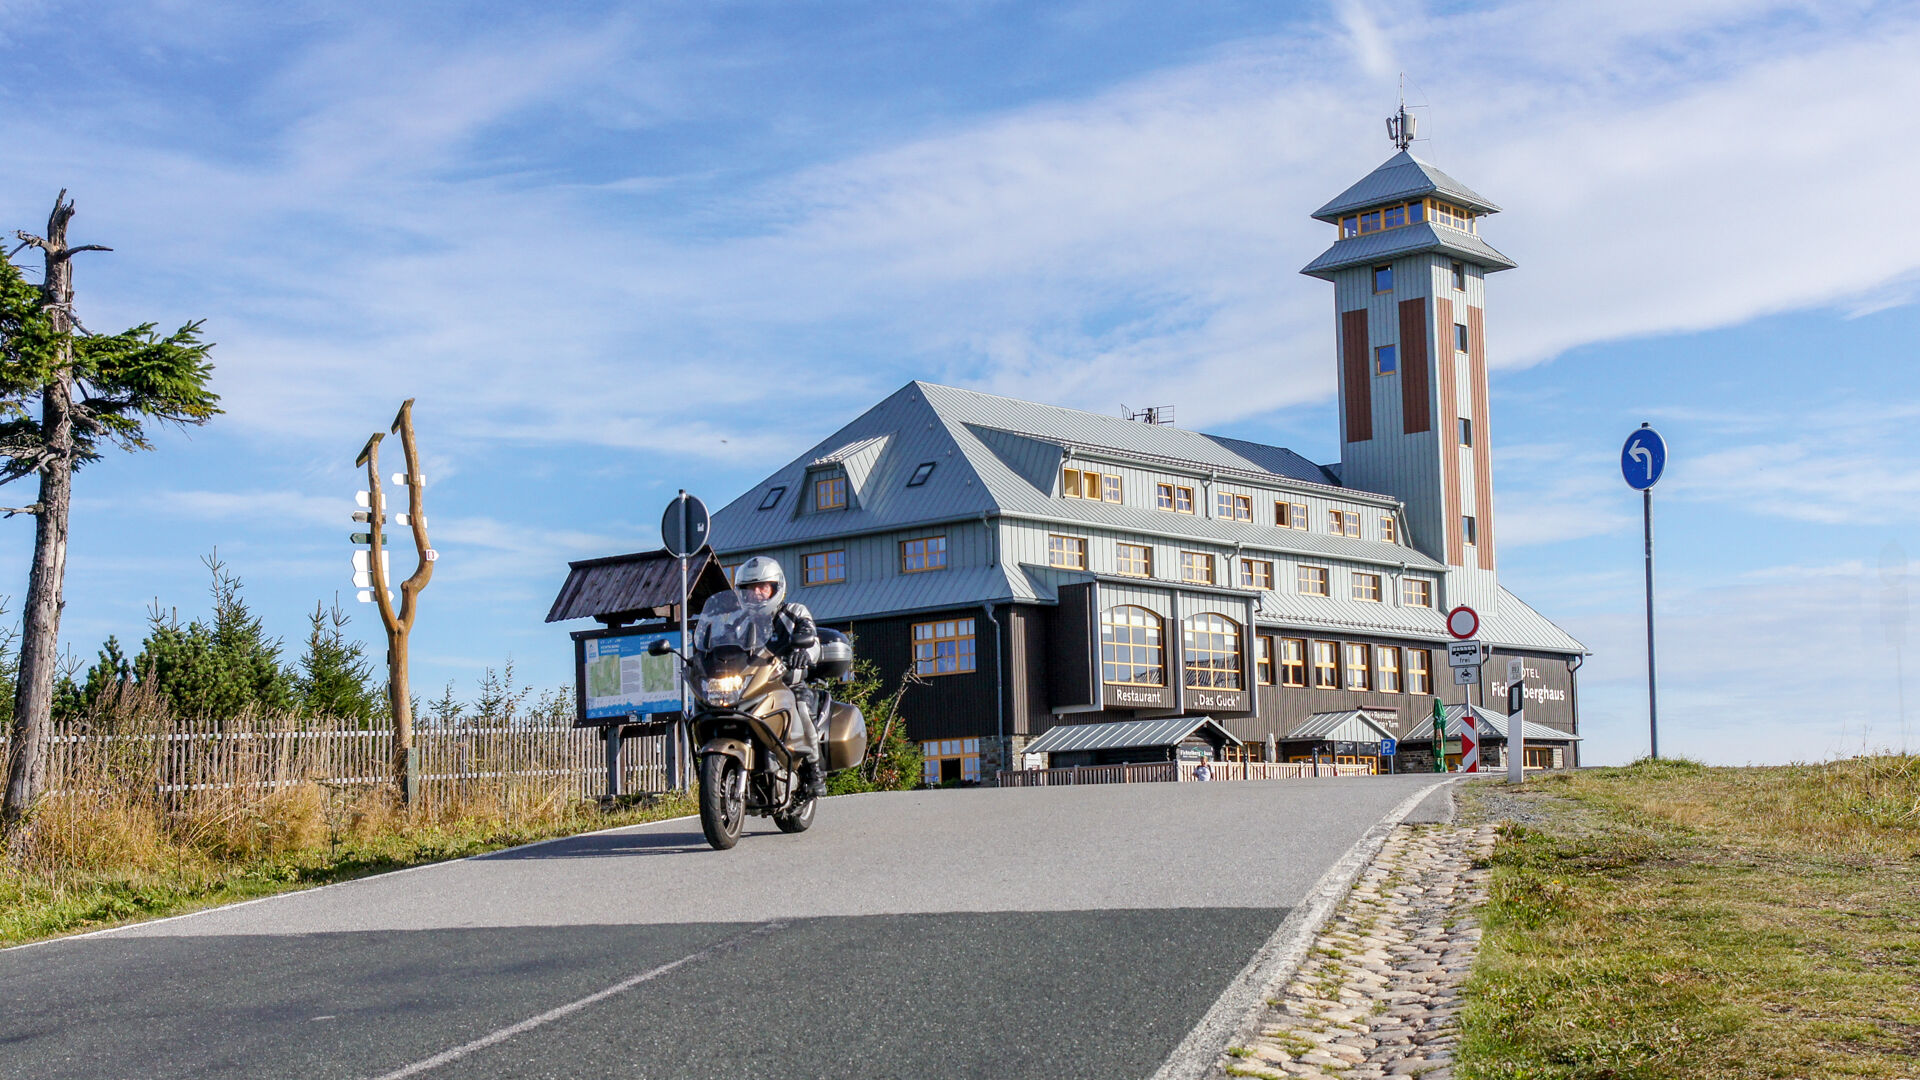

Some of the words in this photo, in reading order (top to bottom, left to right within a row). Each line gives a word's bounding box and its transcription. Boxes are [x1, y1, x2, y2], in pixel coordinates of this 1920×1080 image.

[1116, 689, 1161, 703] Restaurant
[1491, 682, 1565, 704] Fichberghaus
[1382, 741, 1391, 754] P
